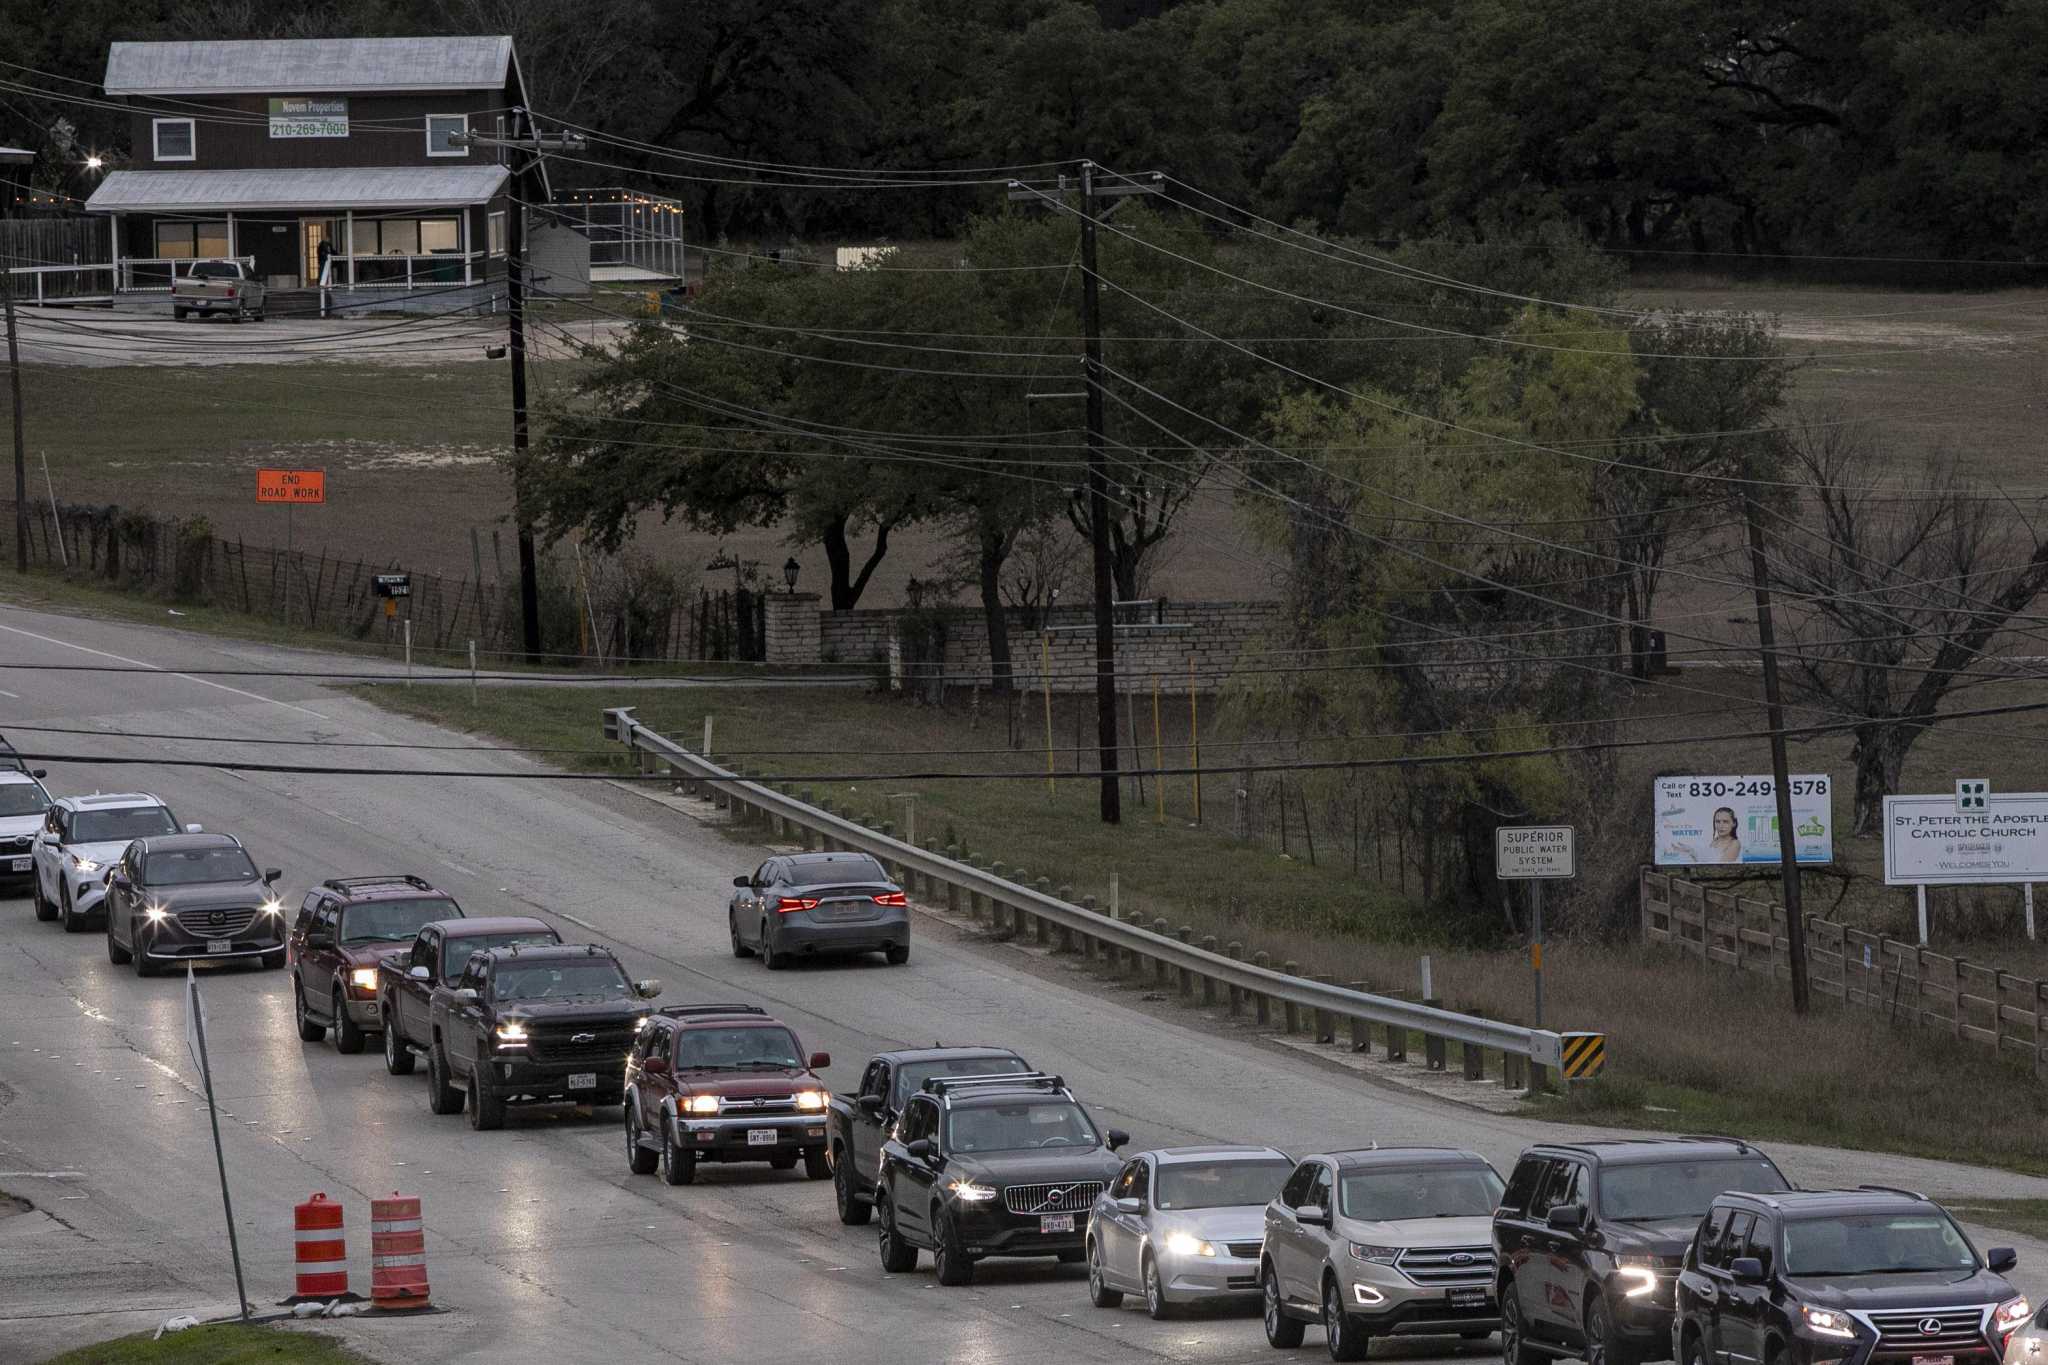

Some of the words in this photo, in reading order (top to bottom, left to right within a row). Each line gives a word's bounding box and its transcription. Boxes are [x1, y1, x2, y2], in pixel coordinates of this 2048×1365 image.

[308, 101, 345, 114] Properties
[281, 475, 300, 484] END
[261, 487, 286, 496] ROAD
[293, 488, 320, 498] WORK
[1690, 781, 1827, 797] 830-249-578
[1919, 816, 1961, 825] PETER
[1964, 816, 1989, 824] THE
[1507, 832, 1563, 843] SUPERIOR
[1911, 829, 1977, 838] CATHOLIC
[1980, 828, 2036, 837] CHURCH
[1503, 846, 1534, 854] PUBLIC
[1540, 845, 1567, 853] WATER
